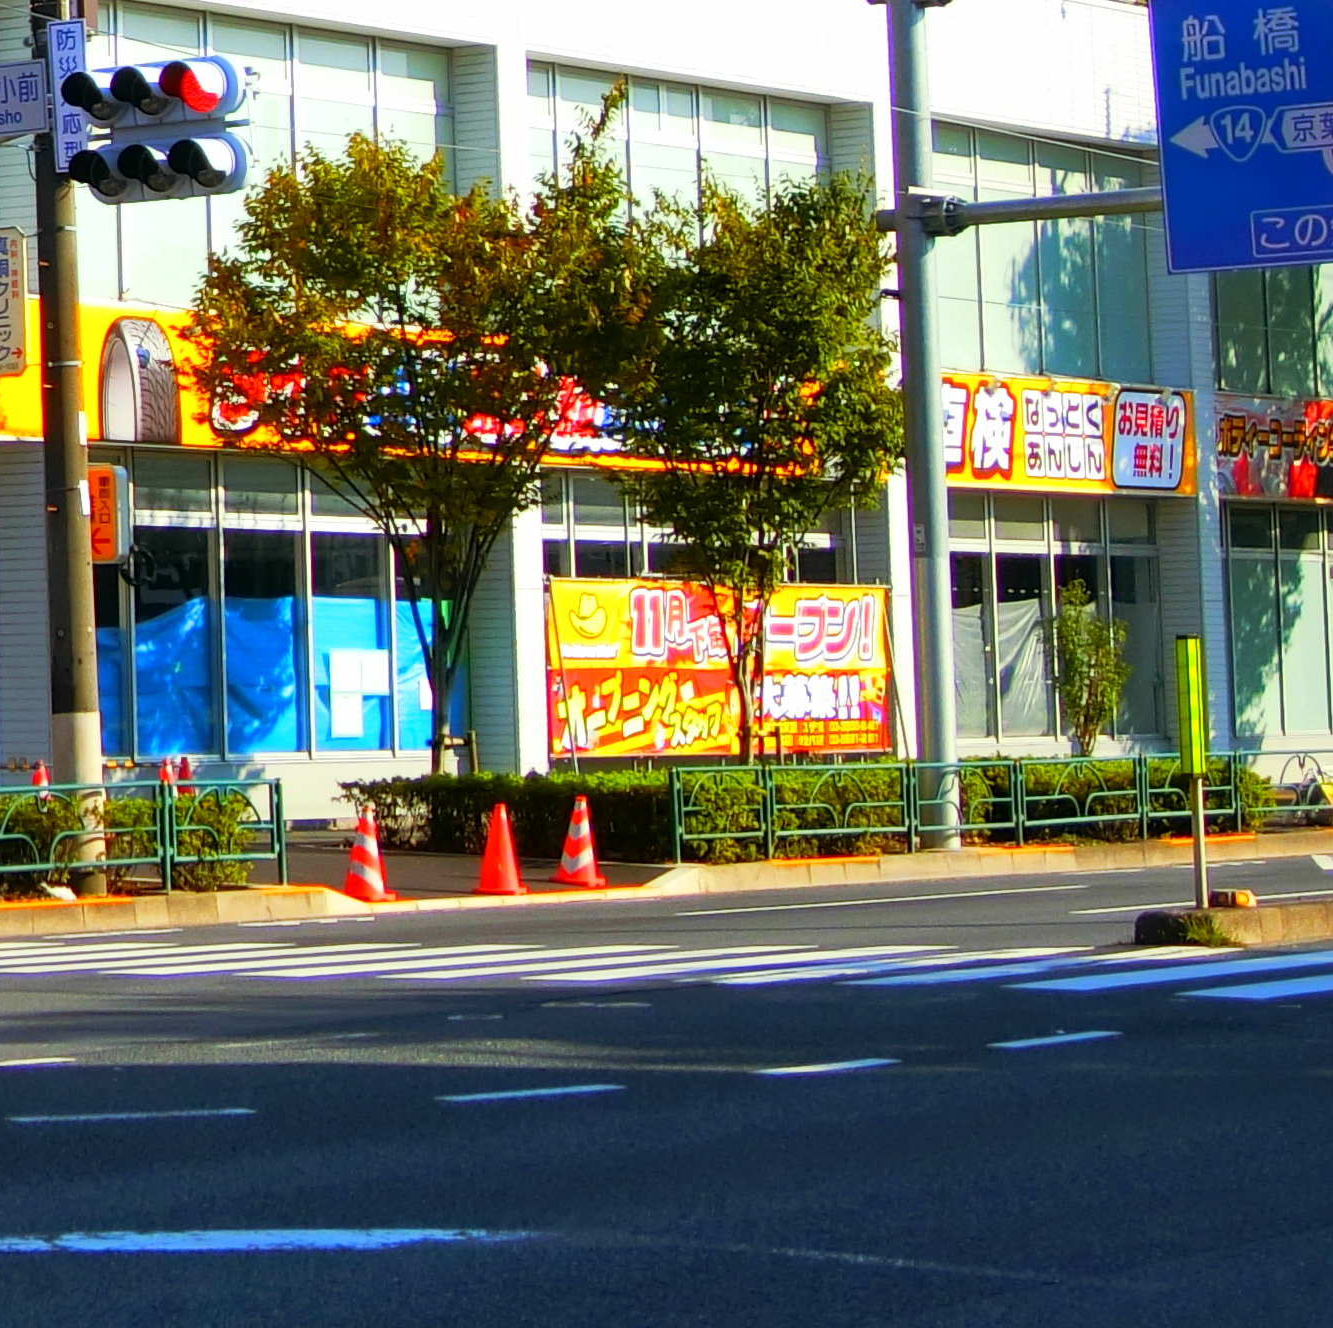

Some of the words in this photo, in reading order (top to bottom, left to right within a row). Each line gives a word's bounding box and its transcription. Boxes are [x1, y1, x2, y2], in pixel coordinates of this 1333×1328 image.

[1181, 5, 1301, 63] 船橋
[55, 29, 83, 164] 防災応型
[1180, 56, 1308, 101] Funabashi
[1220, 112, 1255, 145] 14
[1260, 214, 1333, 249] この
